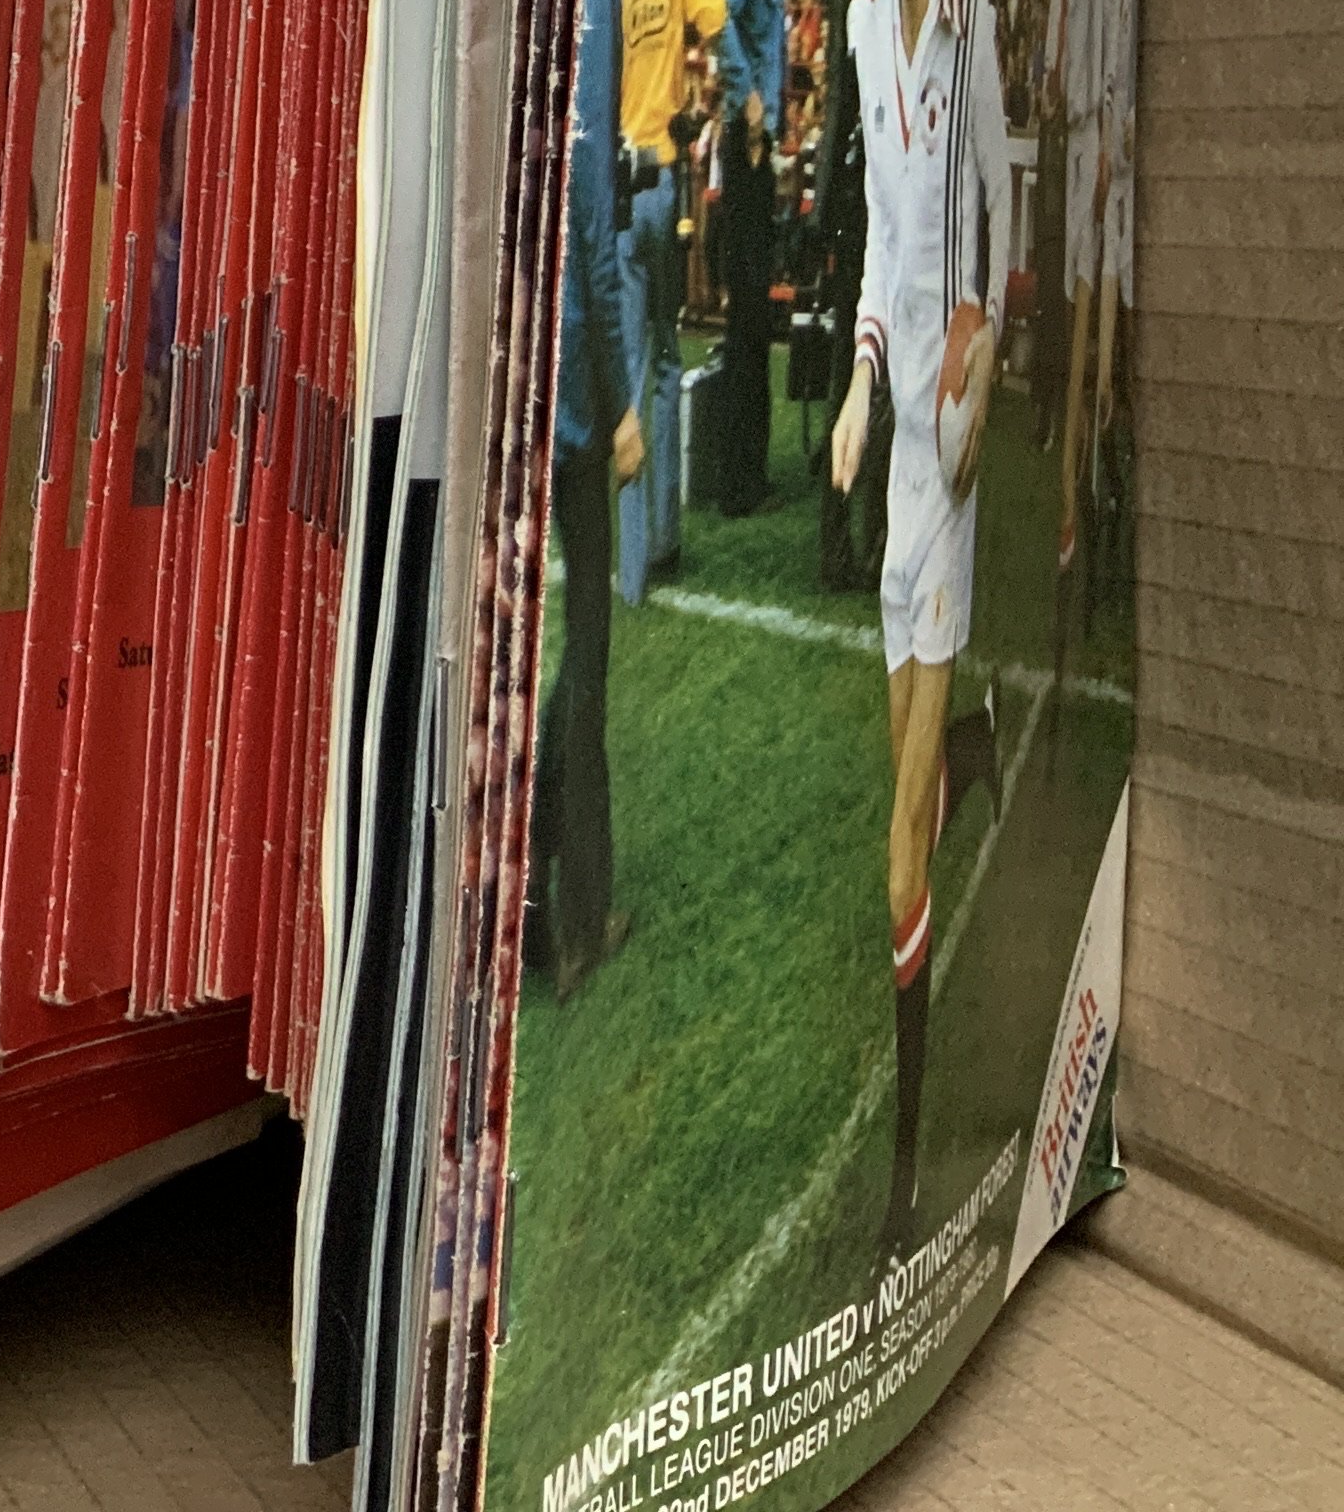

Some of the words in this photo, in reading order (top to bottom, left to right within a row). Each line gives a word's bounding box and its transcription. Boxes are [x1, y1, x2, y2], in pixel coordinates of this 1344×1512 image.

[1041, 988, 1098, 1190] British
[543, 1362, 753, 1512] MANCHESTER
[761, 1304, 858, 1398] UNITED
[879, 1185, 980, 1324] NOTTINGHAM
[650, 1416, 744, 1492] LEAGUE
[750, 1370, 835, 1449] DIVISION
[881, 1289, 933, 1362] SEASON
[715, 1417, 829, 1507] DECEMBER
[876, 1328, 934, 1406] KICK-OFF
